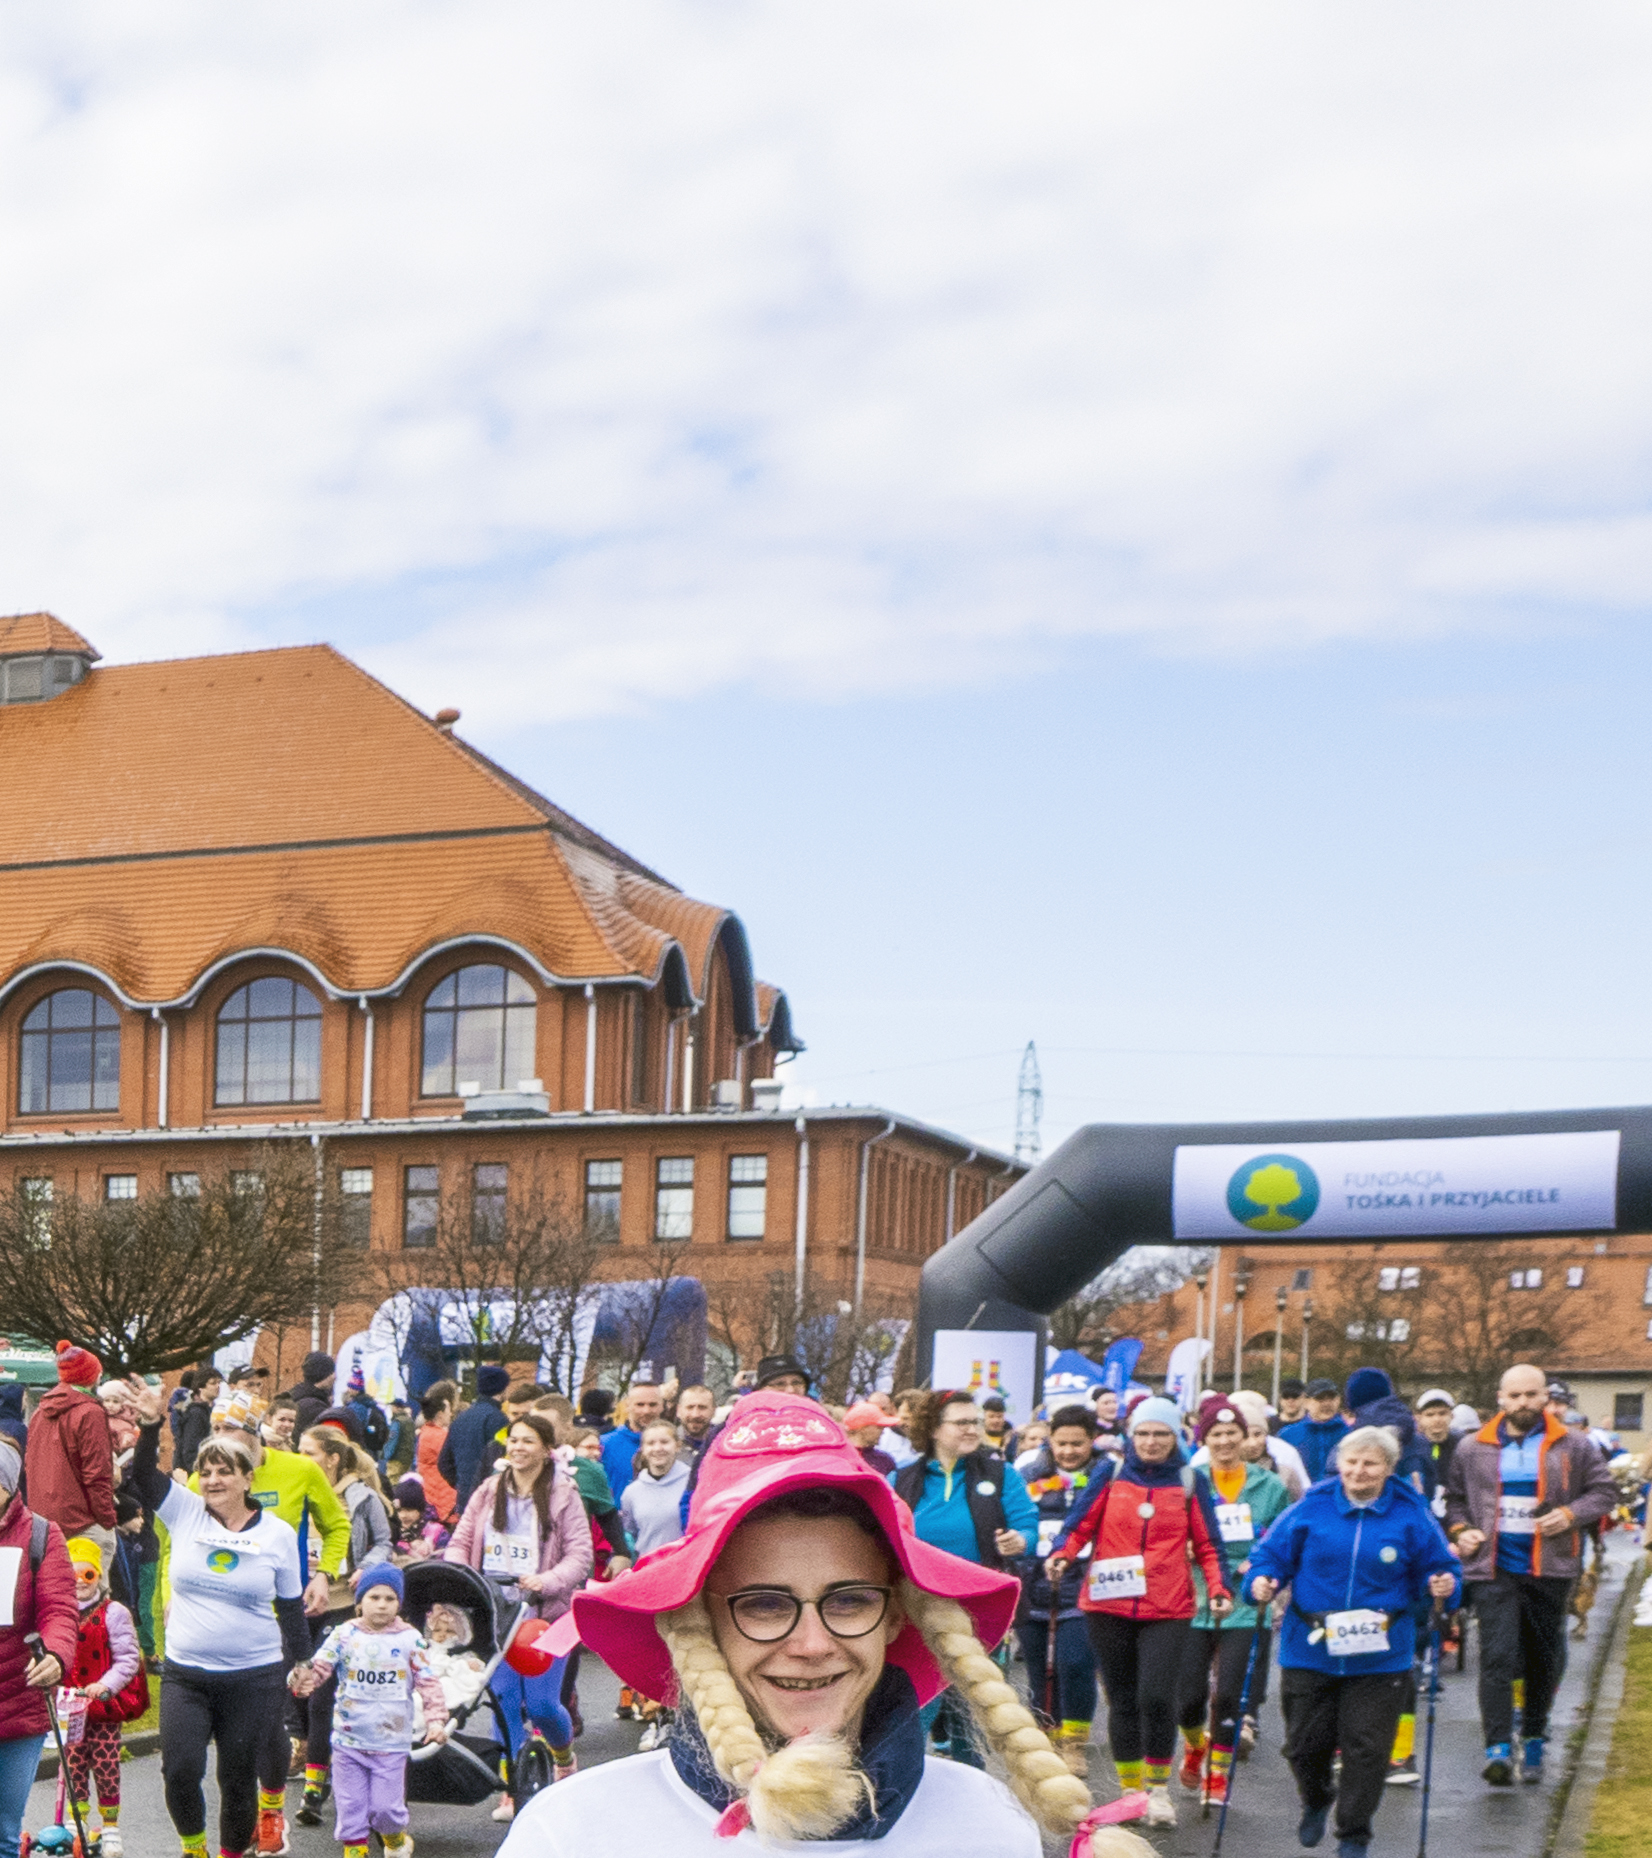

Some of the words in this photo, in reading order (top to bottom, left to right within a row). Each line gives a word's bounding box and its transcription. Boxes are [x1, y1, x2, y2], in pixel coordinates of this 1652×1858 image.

[1345, 1171, 1445, 1188] FUNDACJA
[1346, 1190, 1411, 1209] TOŚKA
[1430, 1187, 1560, 1209] PRZYJACIELE
[493, 1545, 529, 1559] 033
[356, 1669, 397, 1684] 0082
